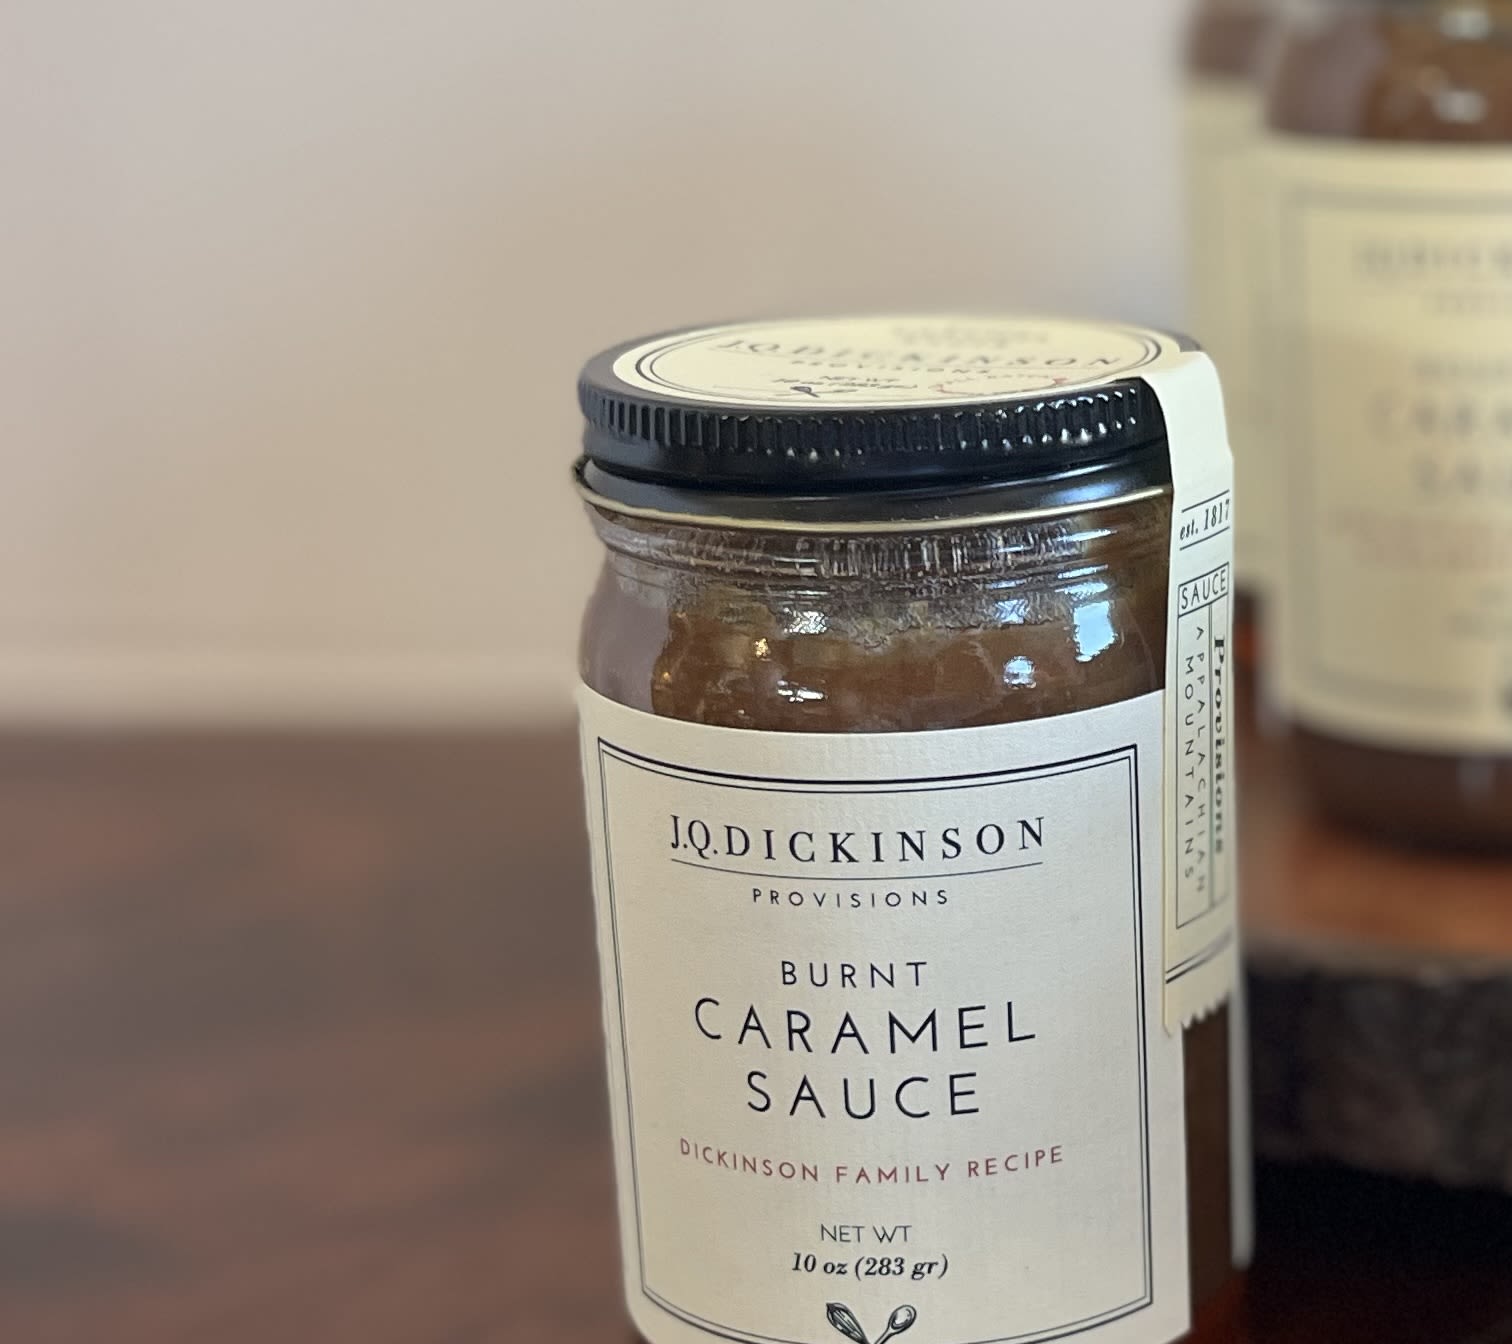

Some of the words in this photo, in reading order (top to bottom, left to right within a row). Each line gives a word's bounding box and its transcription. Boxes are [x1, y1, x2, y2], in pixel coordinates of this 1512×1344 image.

[1180, 519, 1199, 541] est.
[1203, 498, 1230, 531] 1817
[1181, 568, 1227, 610] SAUCE
[1184, 656, 1195, 878] MOUNTAINS
[753, 888, 949, 909] PROVISIONS
[781, 961, 928, 989] BURNT
[695, 998, 1036, 1055] CARAMEL
[747, 1070, 980, 1120] SAUCE
[680, 1137, 820, 1182] DICKINSON
[835, 1162, 951, 1185] FAMILY
[966, 1145, 1064, 1179] RECIPE
[821, 1224, 865, 1244] NET
[873, 1224, 912, 1244] WT
[791, 1252, 817, 1273] 10
[823, 1260, 849, 1276] oz
[854, 1255, 905, 1282] (283
[911, 1253, 949, 1282] gr)
